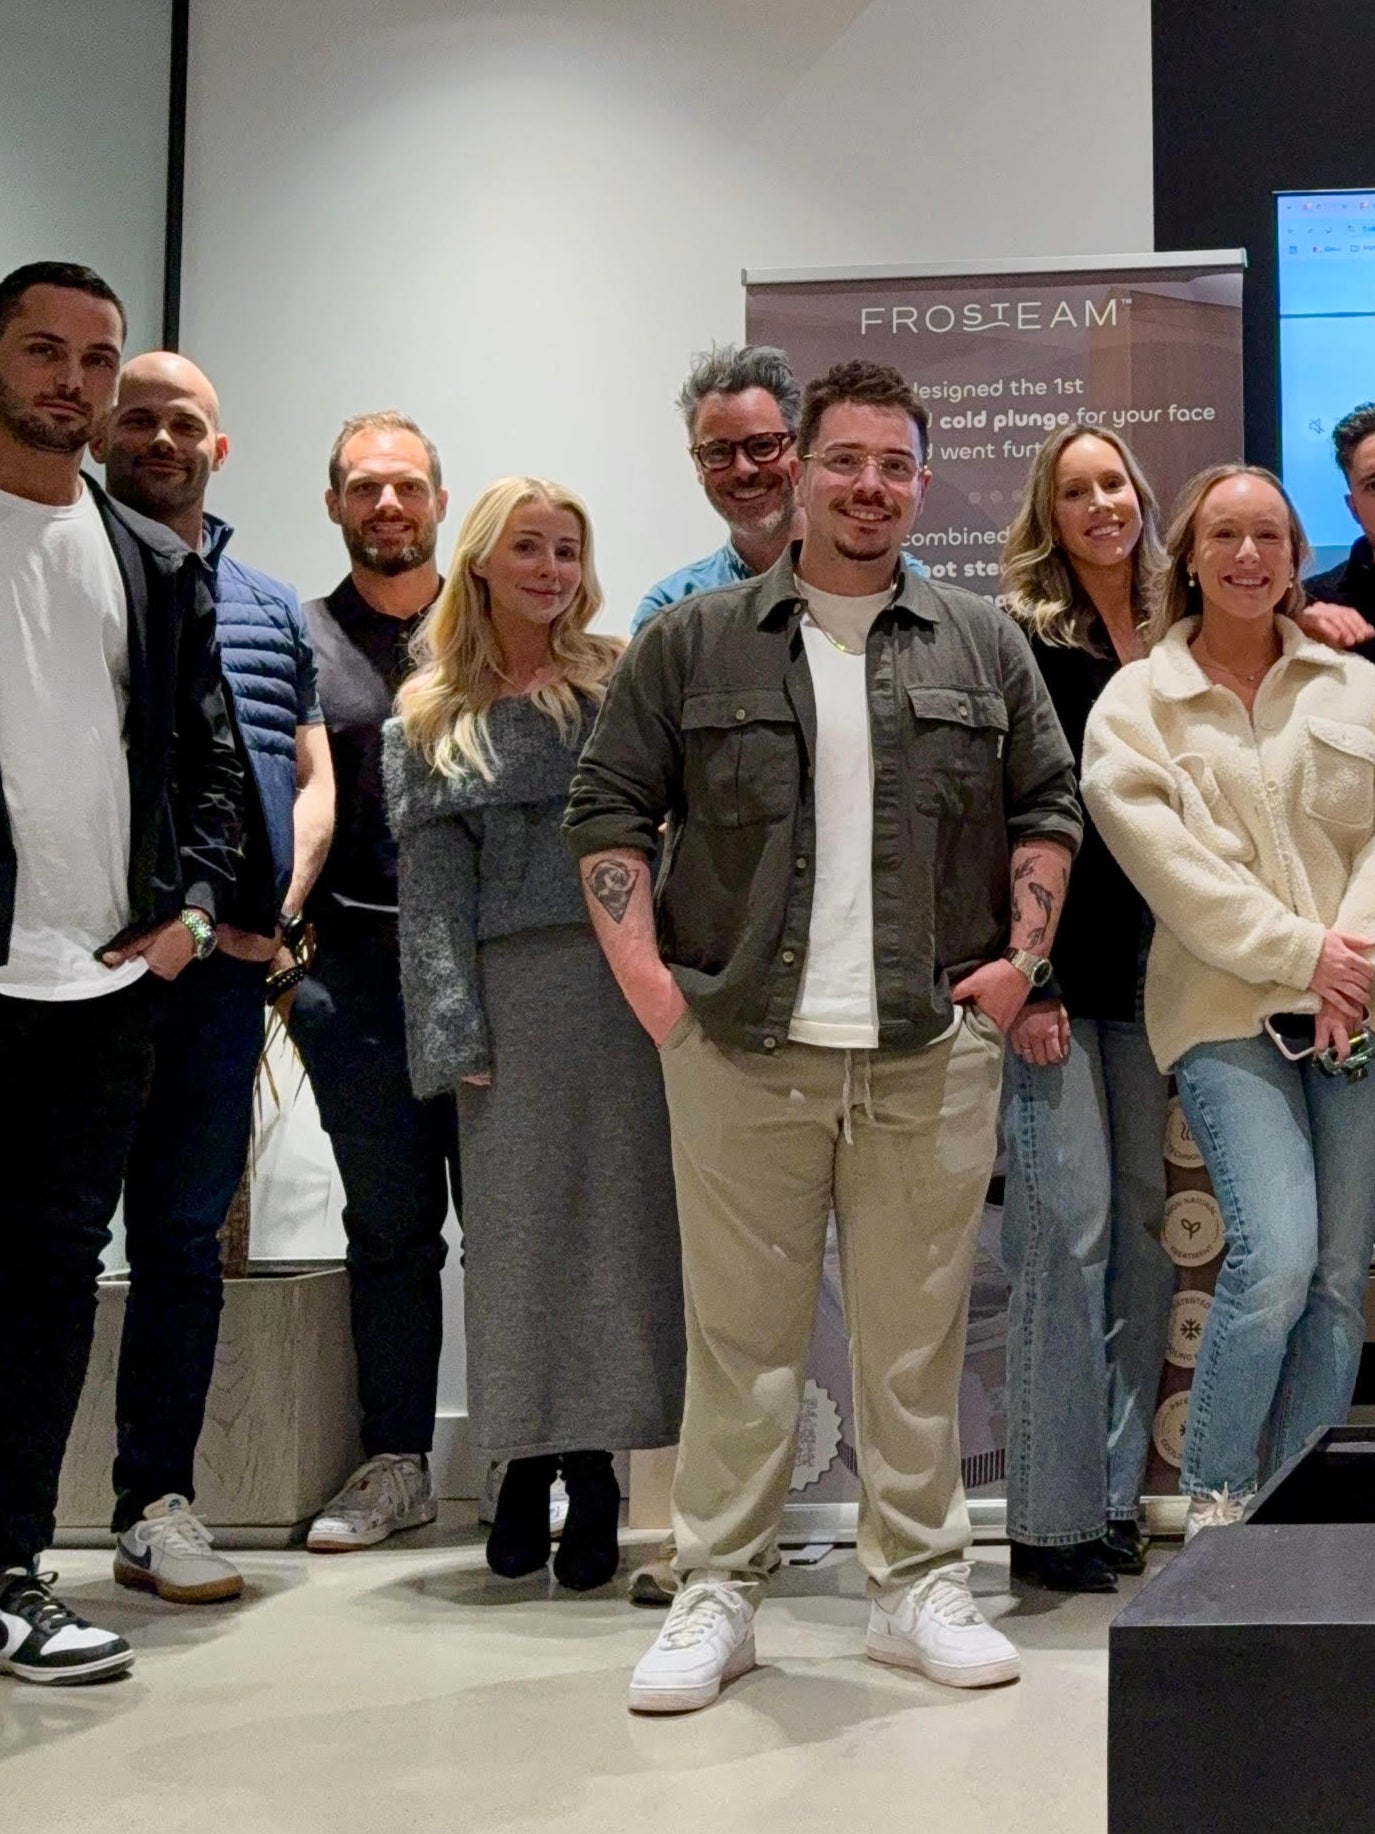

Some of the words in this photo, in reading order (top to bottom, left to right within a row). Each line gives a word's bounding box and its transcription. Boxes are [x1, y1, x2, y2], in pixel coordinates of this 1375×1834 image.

[1009, 378, 1047, 397] the
[1053, 377, 1084, 395] 1st
[939, 410, 987, 430] cold
[993, 408, 1070, 433] plunge
[1076, 406, 1106, 425] for
[1112, 408, 1163, 428] your
[1167, 404, 1216, 422] face
[940, 443, 996, 461] went
[1002, 440, 1043, 459] furt
[963, 560, 1001, 578] ste
[1176, 1296, 1211, 1310] ATENTED
